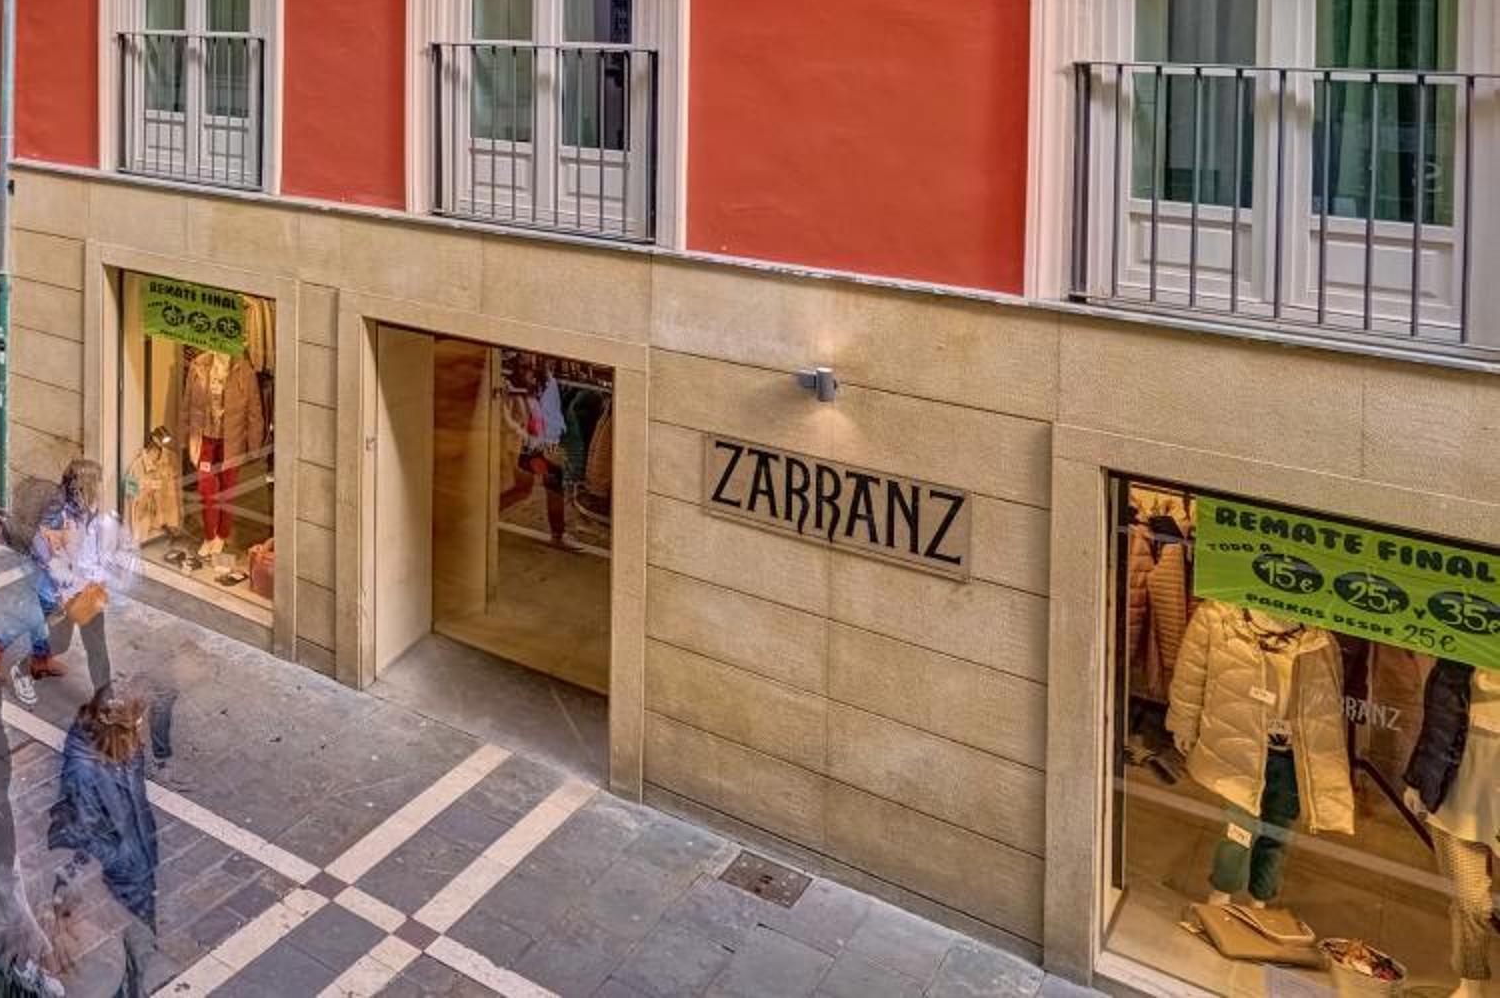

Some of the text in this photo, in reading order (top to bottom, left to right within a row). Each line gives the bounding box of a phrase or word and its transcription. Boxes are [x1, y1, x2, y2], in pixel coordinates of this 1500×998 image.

[711, 440, 965, 565] ZARRANZ
[1215, 506, 1495, 583] REMATE FINAL
[1245, 593, 1325, 619] PARKAS
[1333, 614, 1394, 635] DESDE
